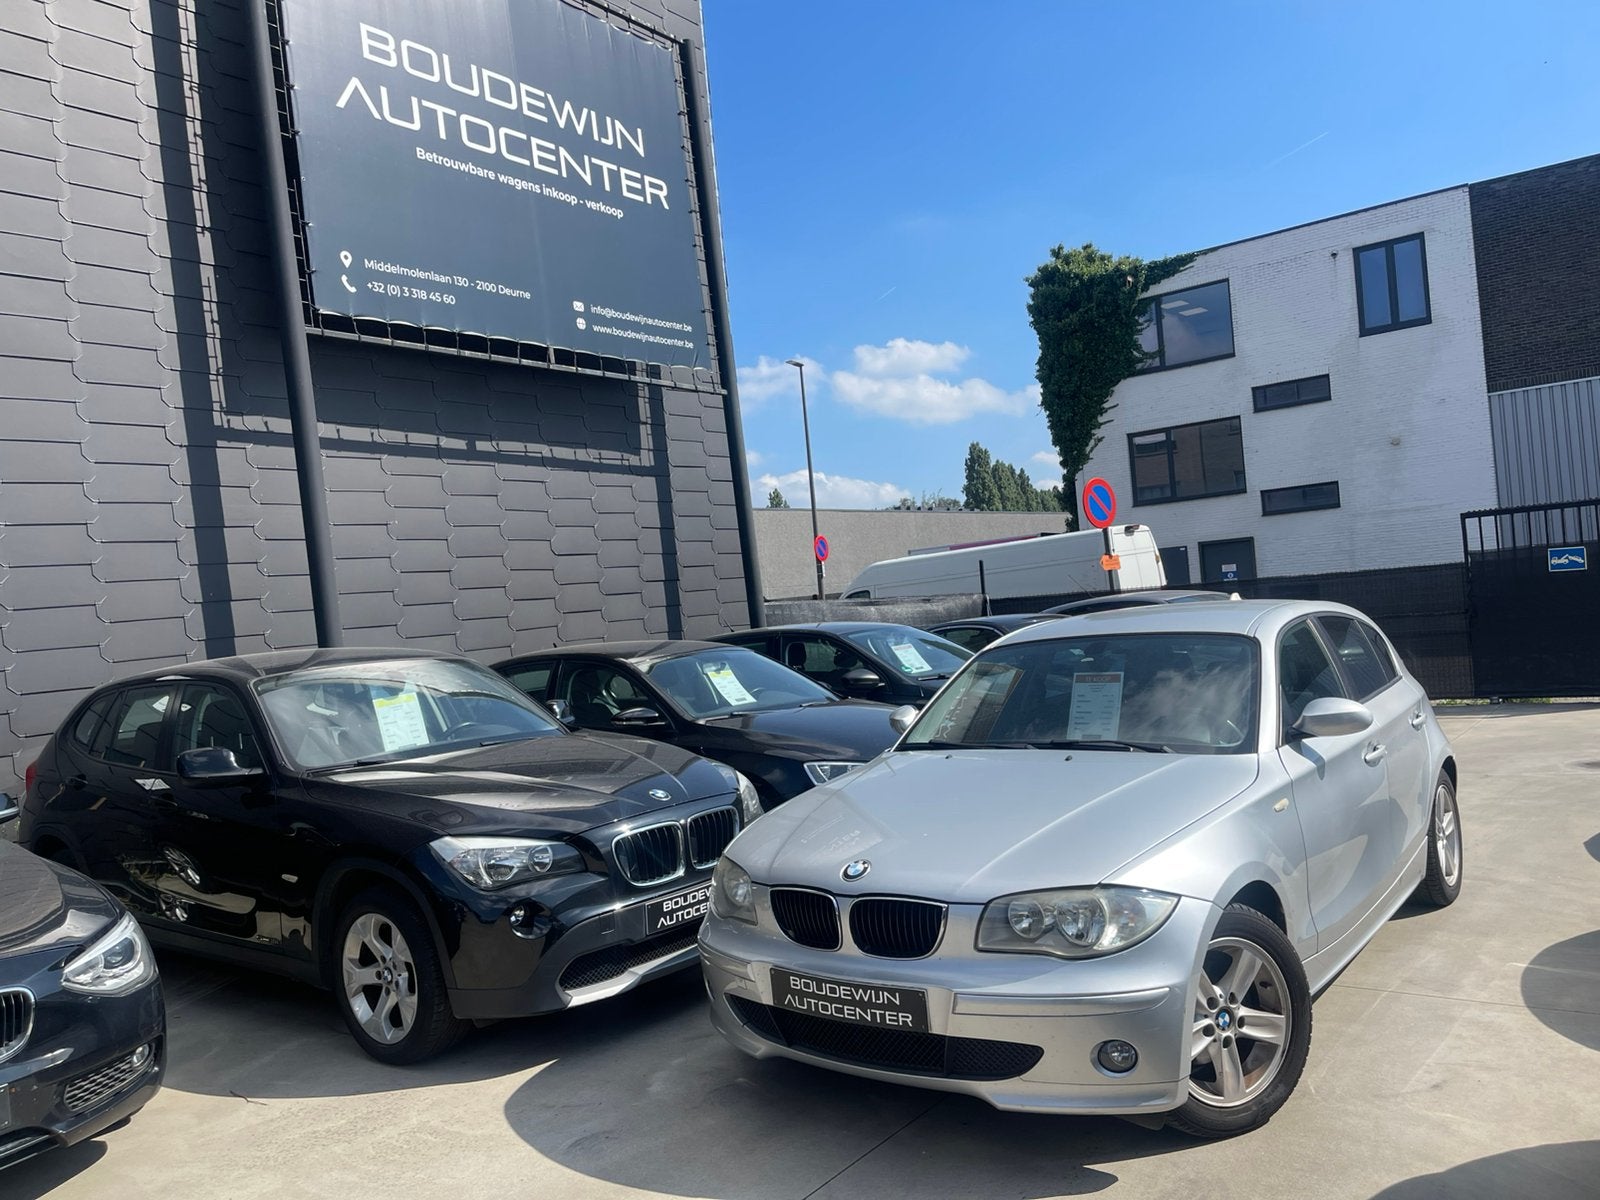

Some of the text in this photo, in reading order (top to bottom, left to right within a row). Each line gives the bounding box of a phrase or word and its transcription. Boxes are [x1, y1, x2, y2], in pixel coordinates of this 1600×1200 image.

[359, 22, 645, 157] BOUDEWIJN
[335, 76, 669, 209] AUTOCENTER
[416, 147, 496, 181] Betrouwbare
[497, 172, 541, 193] wagens
[542, 184, 578, 206] inkoop
[585, 199, 624, 219] verkoop
[364, 258, 452, 284] Middelmolenlaan
[453, 275, 469, 287] 130
[475, 281, 497, 293] 2100
[498, 285, 531, 299] Deurne
[367, 281, 456, 305] +32 (0) 3 318 45 60
[590, 304, 692, 332] info@boudewijnautocenter.be
[592, 324, 694, 349] www.boudewijnautocenter.be
[789, 976, 900, 1005] BOUDEWIJN
[784, 994, 913, 1027] AUTOCENTER
